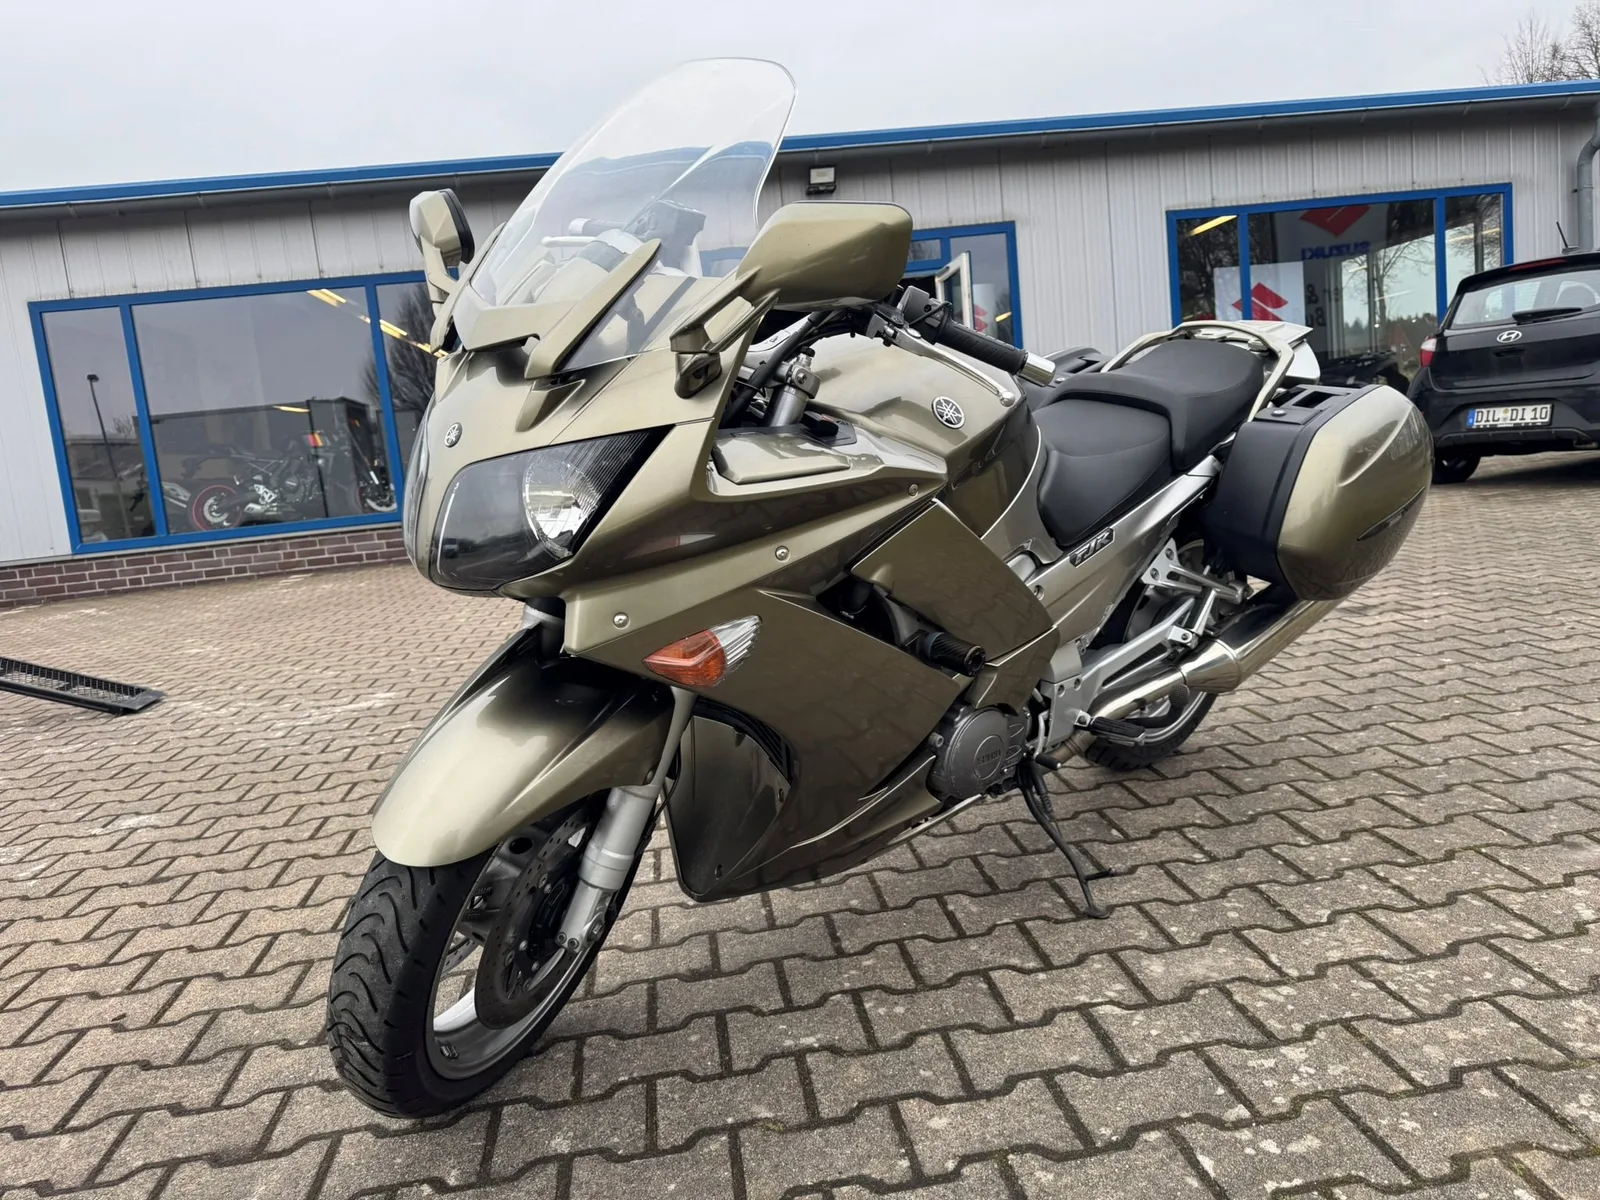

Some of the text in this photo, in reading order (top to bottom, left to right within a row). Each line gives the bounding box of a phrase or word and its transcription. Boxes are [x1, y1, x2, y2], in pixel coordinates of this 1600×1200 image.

[1475, 406, 1549, 423] DIL DI 10
[1073, 531, 1110, 565] FJR
